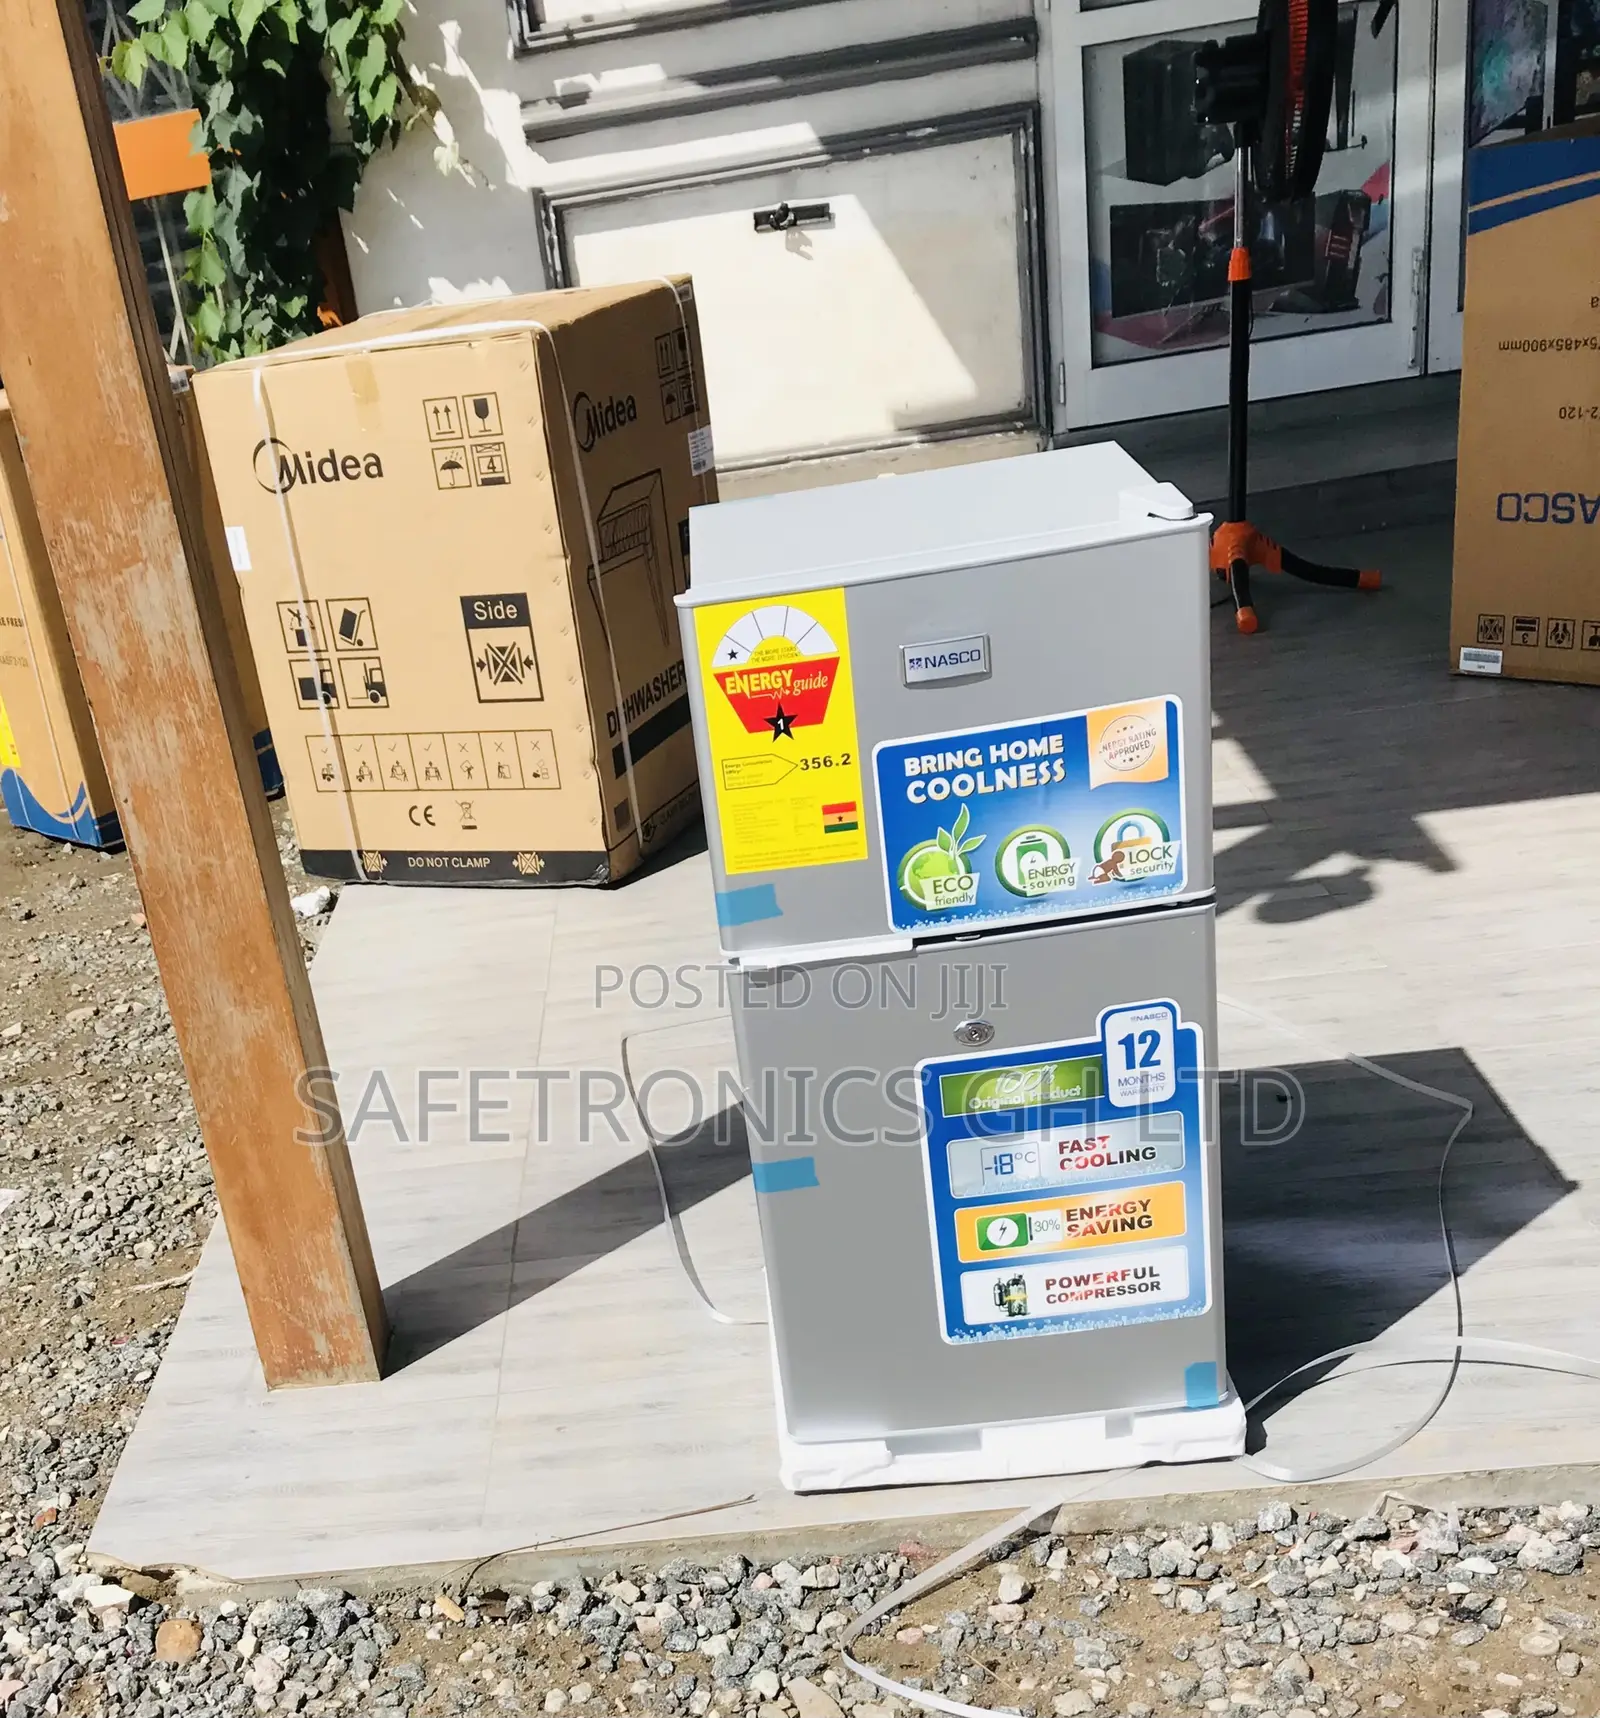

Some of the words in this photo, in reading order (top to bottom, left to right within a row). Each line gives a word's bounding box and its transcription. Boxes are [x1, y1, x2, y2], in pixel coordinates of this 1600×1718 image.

[1498, 336, 1600, 353] 5x485x900mm
[577, 393, 637, 450] Midea
[1558, 405, 1600, 420] 2-120
[262, 440, 384, 491] Midea
[1496, 492, 1600, 524] ASCO
[473, 600, 518, 621] Side
[924, 649, 981, 669] NASCO
[725, 669, 793, 699] ENERGY
[792, 671, 829, 696] guide
[777, 718, 784, 731] 1
[904, 748, 983, 777] BRING
[989, 734, 1064, 764] HOME
[1108, 739, 1151, 761] APPROVED
[800, 753, 851, 771] 356.2
[906, 758, 1066, 804] COOLNESS
[407, 857, 425, 868] DO
[427, 857, 449, 868] NOT
[451, 857, 491, 868] CLAMP
[1129, 845, 1173, 865] LOCK
[1028, 861, 1076, 880] ENERGY
[1129, 860, 1174, 875] security
[933, 875, 974, 895] ECO
[1029, 875, 1076, 891] saving
[934, 892, 975, 907] friendly
[1118, 1029, 1161, 1070] 12
[994, 1064, 1058, 1095] 100%
[1118, 1072, 1166, 1087] MONTHS
[969, 1094, 1026, 1110] Original
[1029, 1084, 1082, 1102] Product
[1120, 1085, 1165, 1097] WARRANTY
[1058, 1135, 1110, 1155] FAST
[1059, 1146, 1157, 1171] COOLING
[1065, 1199, 1152, 1222] ENERGY
[1034, 1217, 1061, 1233] 30%
[1066, 1214, 1153, 1238] SAVING
[1045, 1266, 1160, 1291] POWERFUL
[1046, 1280, 1161, 1304] COMPRESSOR
